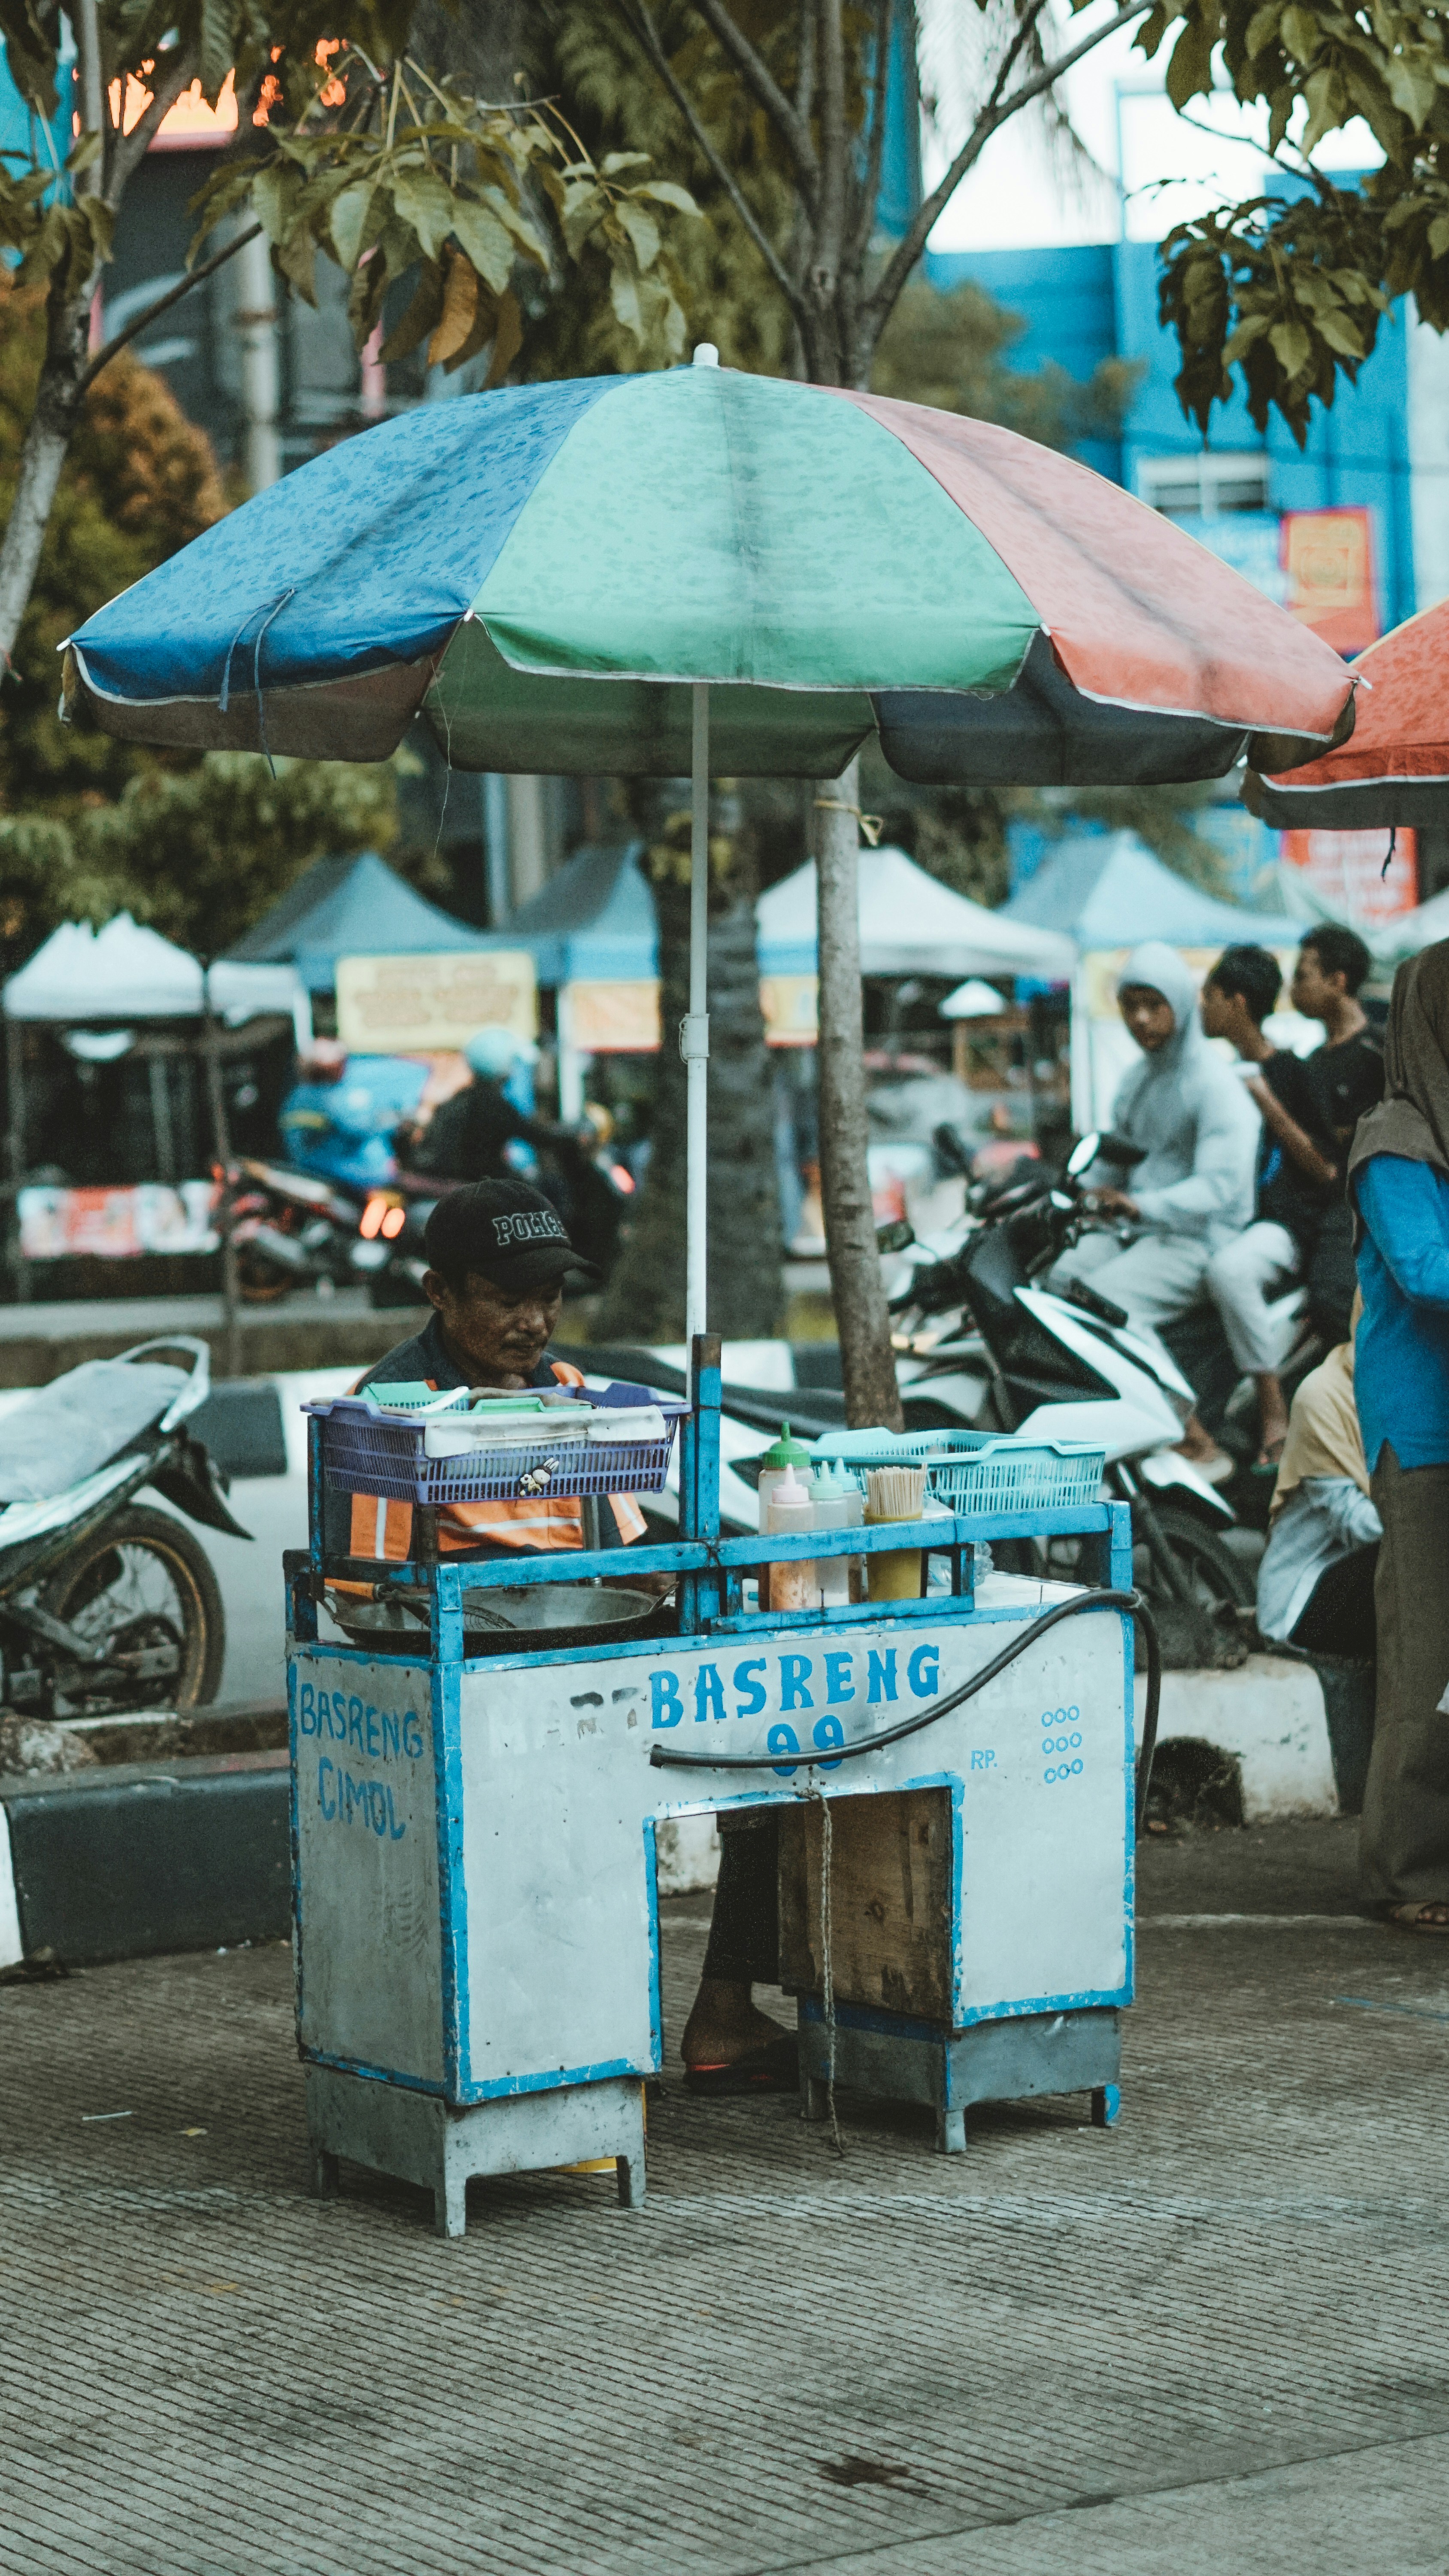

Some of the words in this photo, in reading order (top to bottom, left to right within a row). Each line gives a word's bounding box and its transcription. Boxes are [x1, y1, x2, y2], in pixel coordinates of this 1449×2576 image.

[301, 1683, 424, 1758] BASRENG
[649, 1643, 940, 1729] BASRENG
[767, 1715, 844, 1777] 99
[970, 1749, 997, 1770] RP.
[318, 1756, 406, 1841] CIMOL
